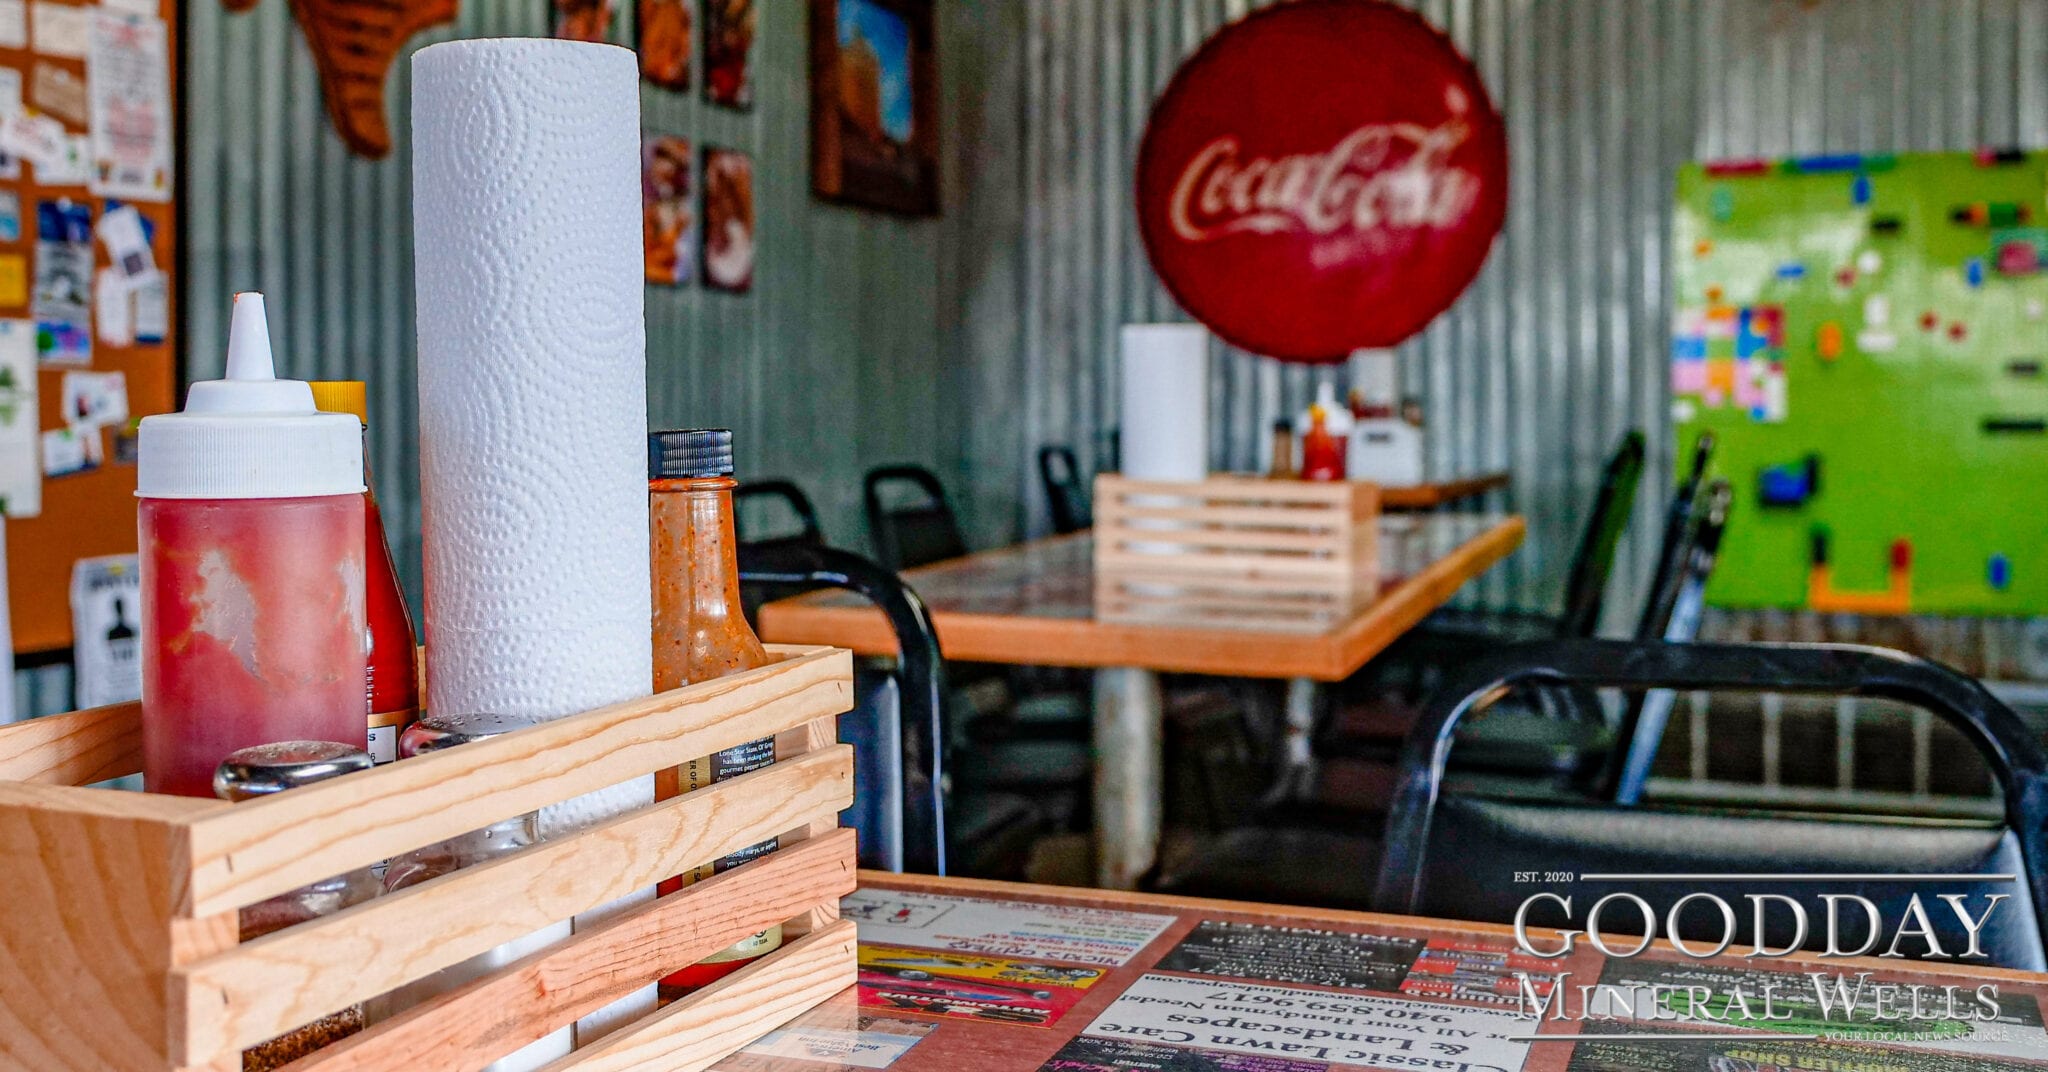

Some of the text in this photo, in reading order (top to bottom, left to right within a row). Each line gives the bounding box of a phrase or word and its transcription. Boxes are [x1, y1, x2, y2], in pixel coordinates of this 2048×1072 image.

[876, 992, 1052, 1015] AUTOMOTIVE
[1118, 994, 1205, 1011] Needs!
[1204, 991, 1453, 1025] 940.859.9617
[1213, 1003, 1358, 1026] Handyman
[1362, 1018, 1428, 1033] Your
[1098, 1022, 1195, 1044] Care
[1164, 1013, 1471, 1056] & Landscapes
[1436, 1028, 1478, 1039] All
[1210, 1034, 1329, 1059] Lawn
[1345, 1050, 1508, 1072] Classic
